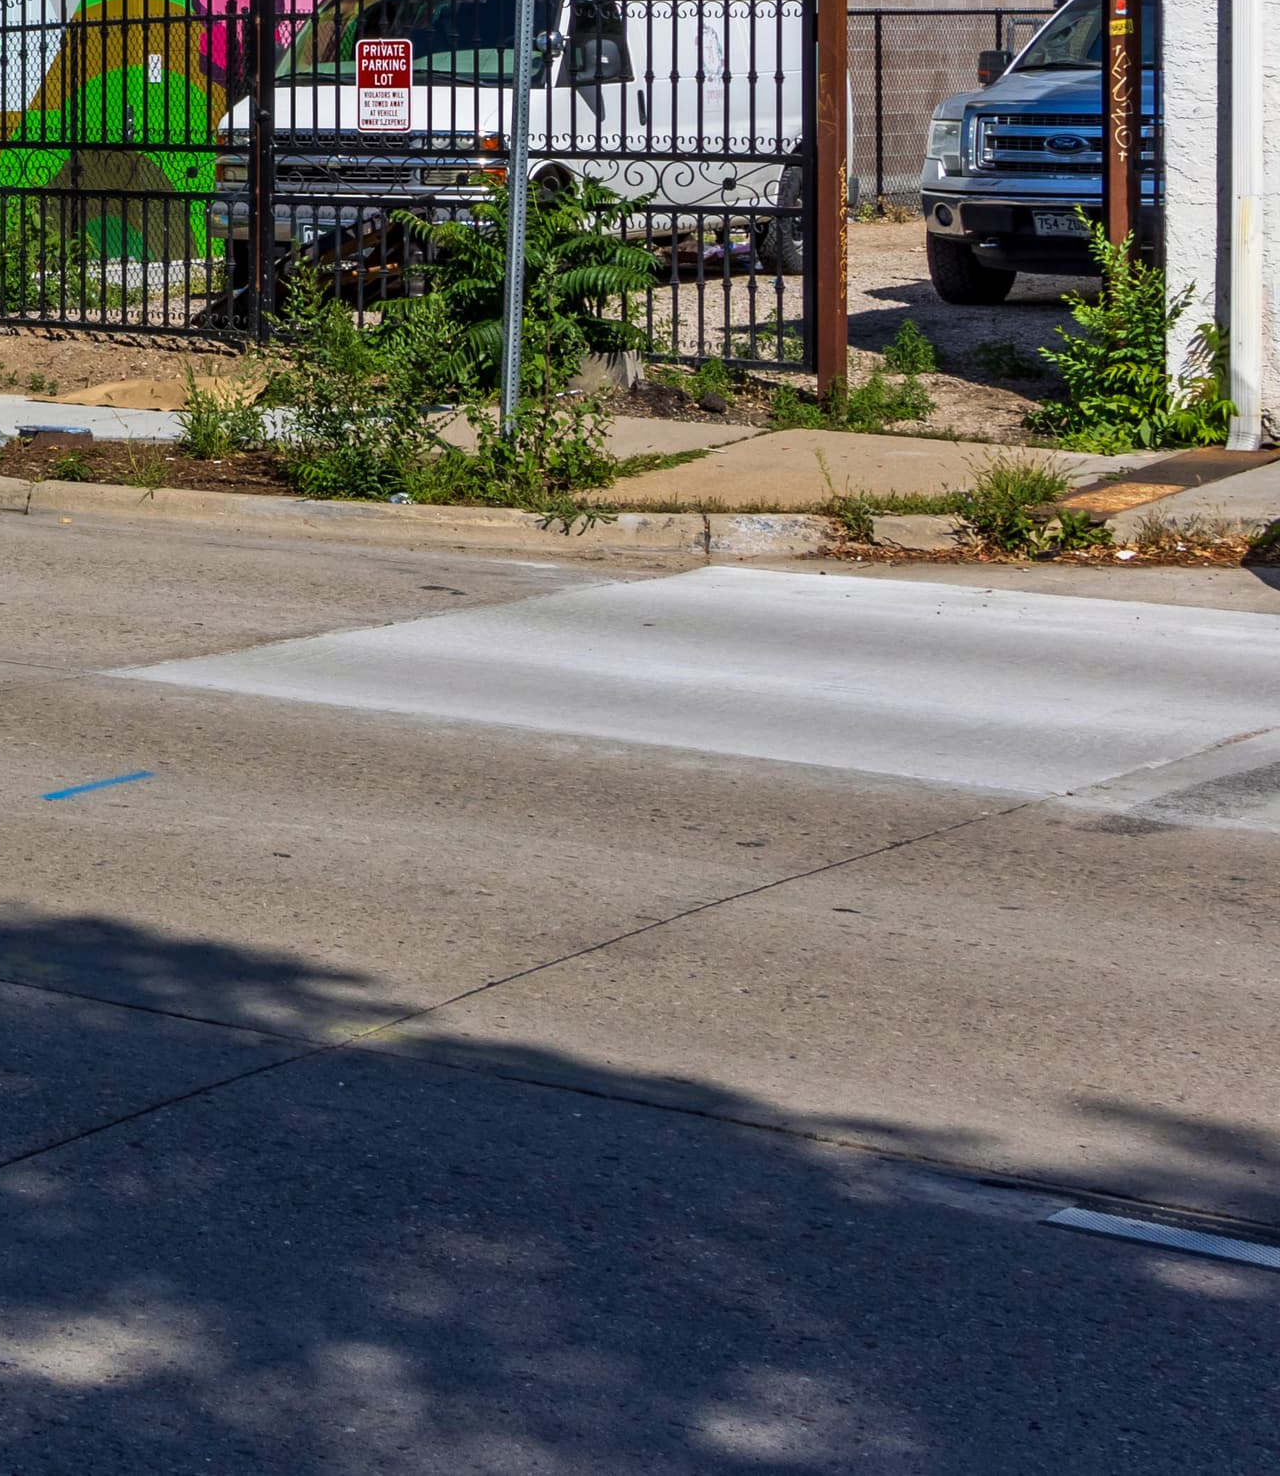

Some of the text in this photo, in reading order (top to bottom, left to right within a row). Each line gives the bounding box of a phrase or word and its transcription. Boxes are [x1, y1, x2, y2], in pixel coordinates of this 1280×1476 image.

[363, 44, 405, 56] PRIVATE
[361, 59, 407, 71] PARKING
[374, 73, 393, 85] LOT
[384, 118, 407, 126] EXPENSE
